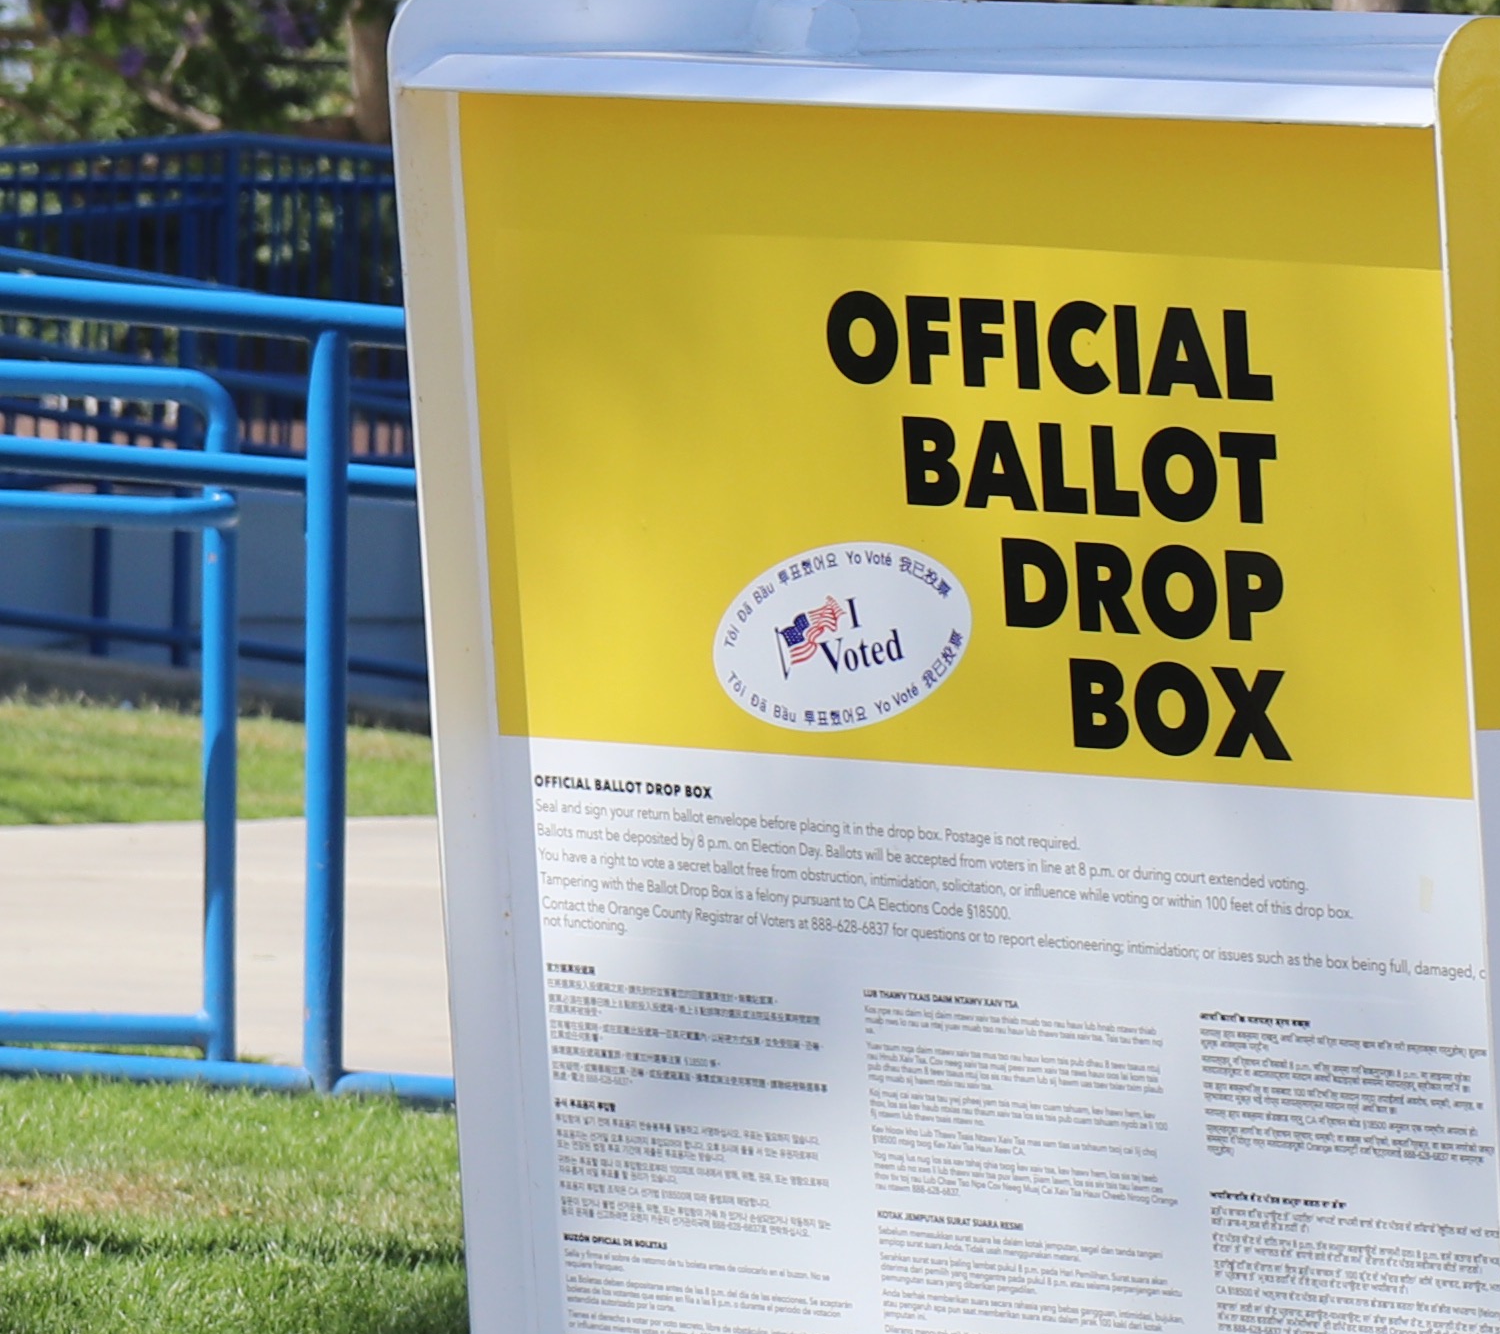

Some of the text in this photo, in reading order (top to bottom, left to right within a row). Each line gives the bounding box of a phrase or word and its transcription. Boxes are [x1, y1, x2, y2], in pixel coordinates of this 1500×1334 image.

[827, 291, 1273, 401] OFFICIAL
[902, 416, 1277, 524] BALLOT
[724, 551, 951, 647] Tôi Đã Bầu 투표했어요 Yo Voté 我已投票
[847, 599, 859, 628] I
[1002, 538, 1283, 641] DROP
[728, 629, 963, 725] Tôi Đã Bầu 투표했어요 Yo Voté 我已投票
[819, 629, 903, 672] Voted
[1069, 658, 1292, 761] BOX
[534, 774, 713, 800] OFFICIAL BALLOT DROP BOX
[535, 799, 884, 838] Seal and sign your return ballot envelope before placing it in the
